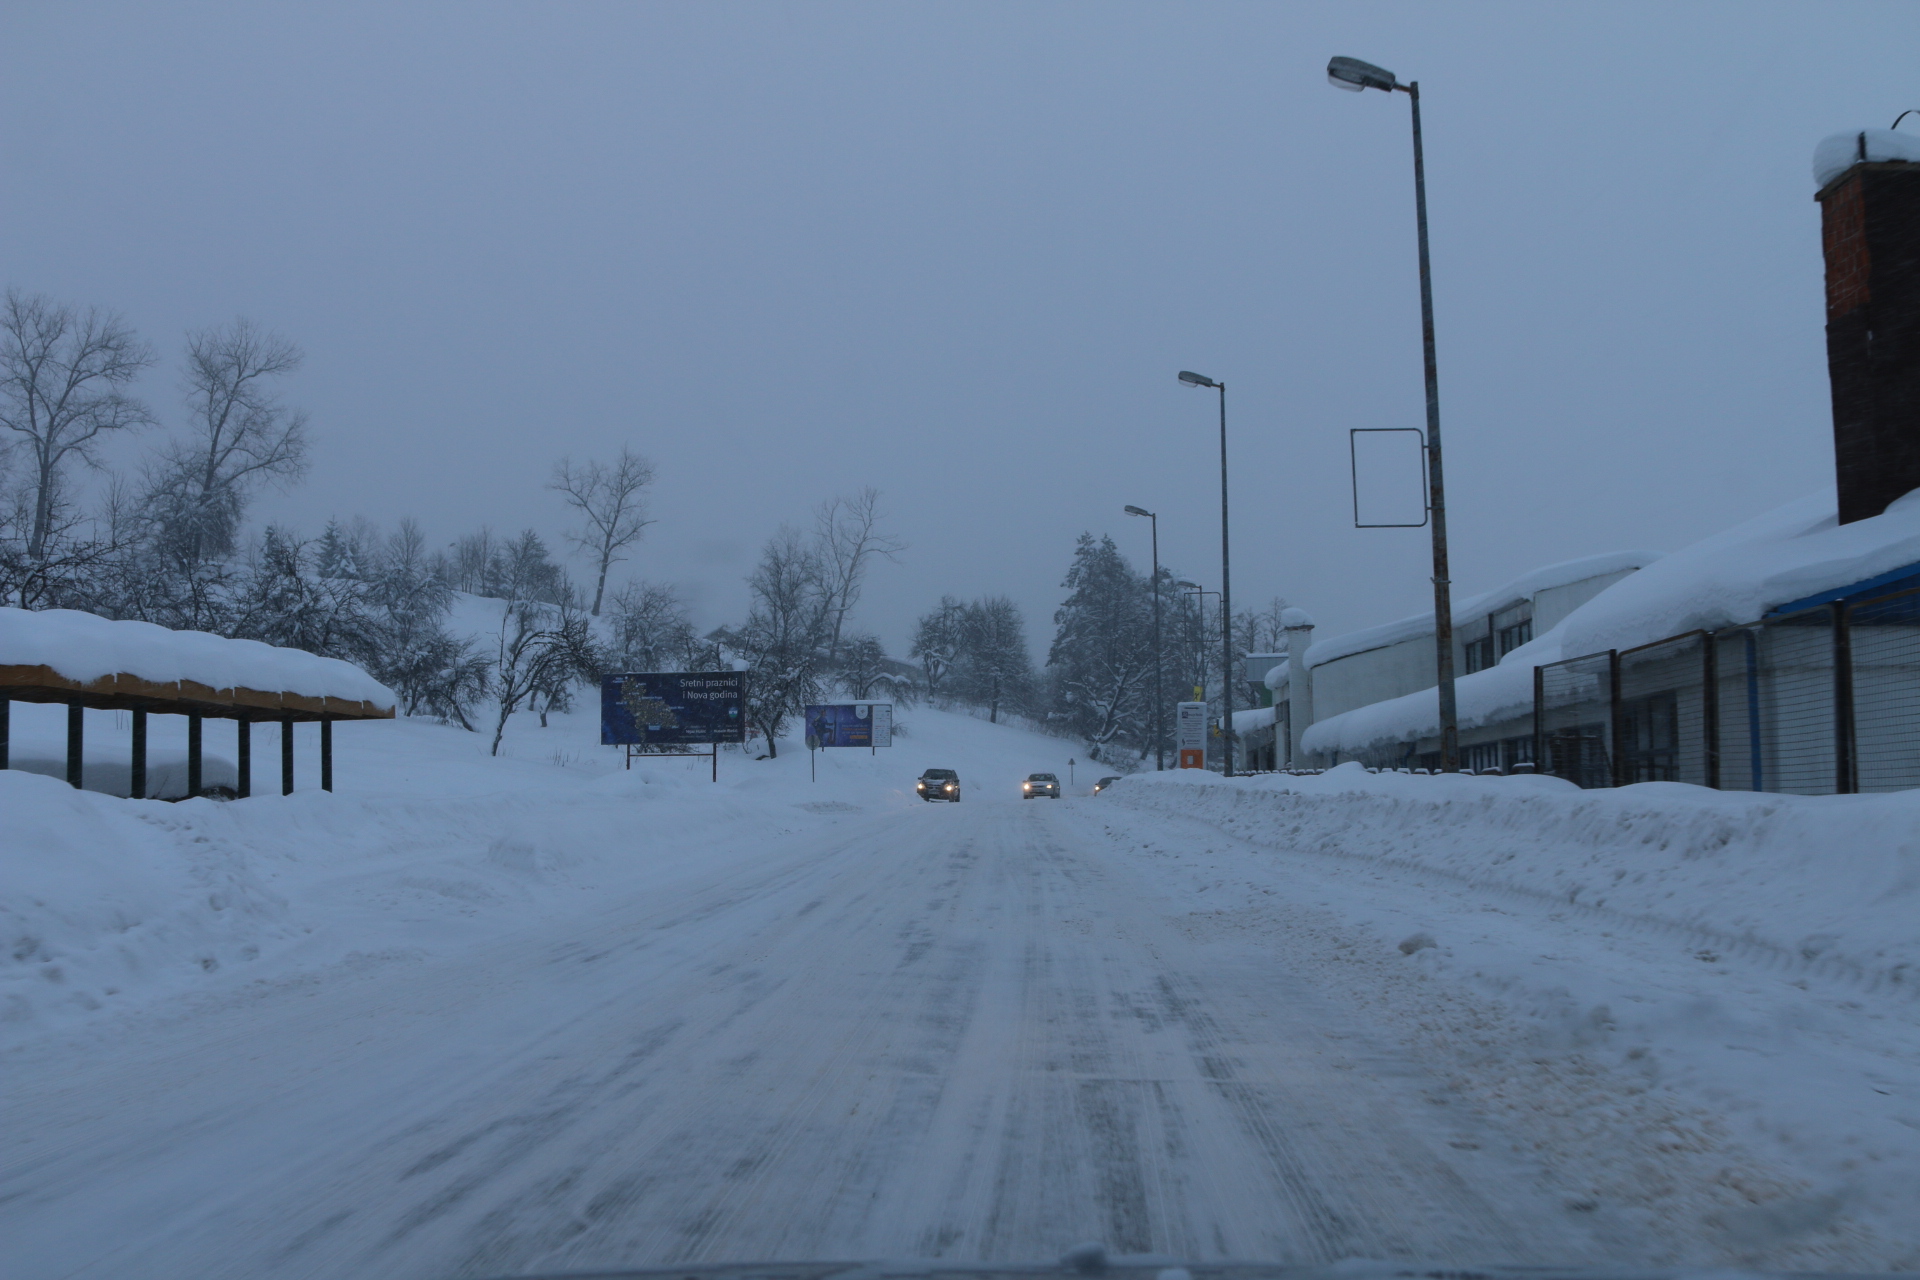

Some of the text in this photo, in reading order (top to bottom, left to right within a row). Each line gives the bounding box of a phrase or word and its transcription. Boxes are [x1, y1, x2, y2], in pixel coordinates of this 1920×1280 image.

[680, 678, 738, 689] Sretni praznici
[687, 691, 708, 699] Nova
[709, 690, 738, 700] godina
